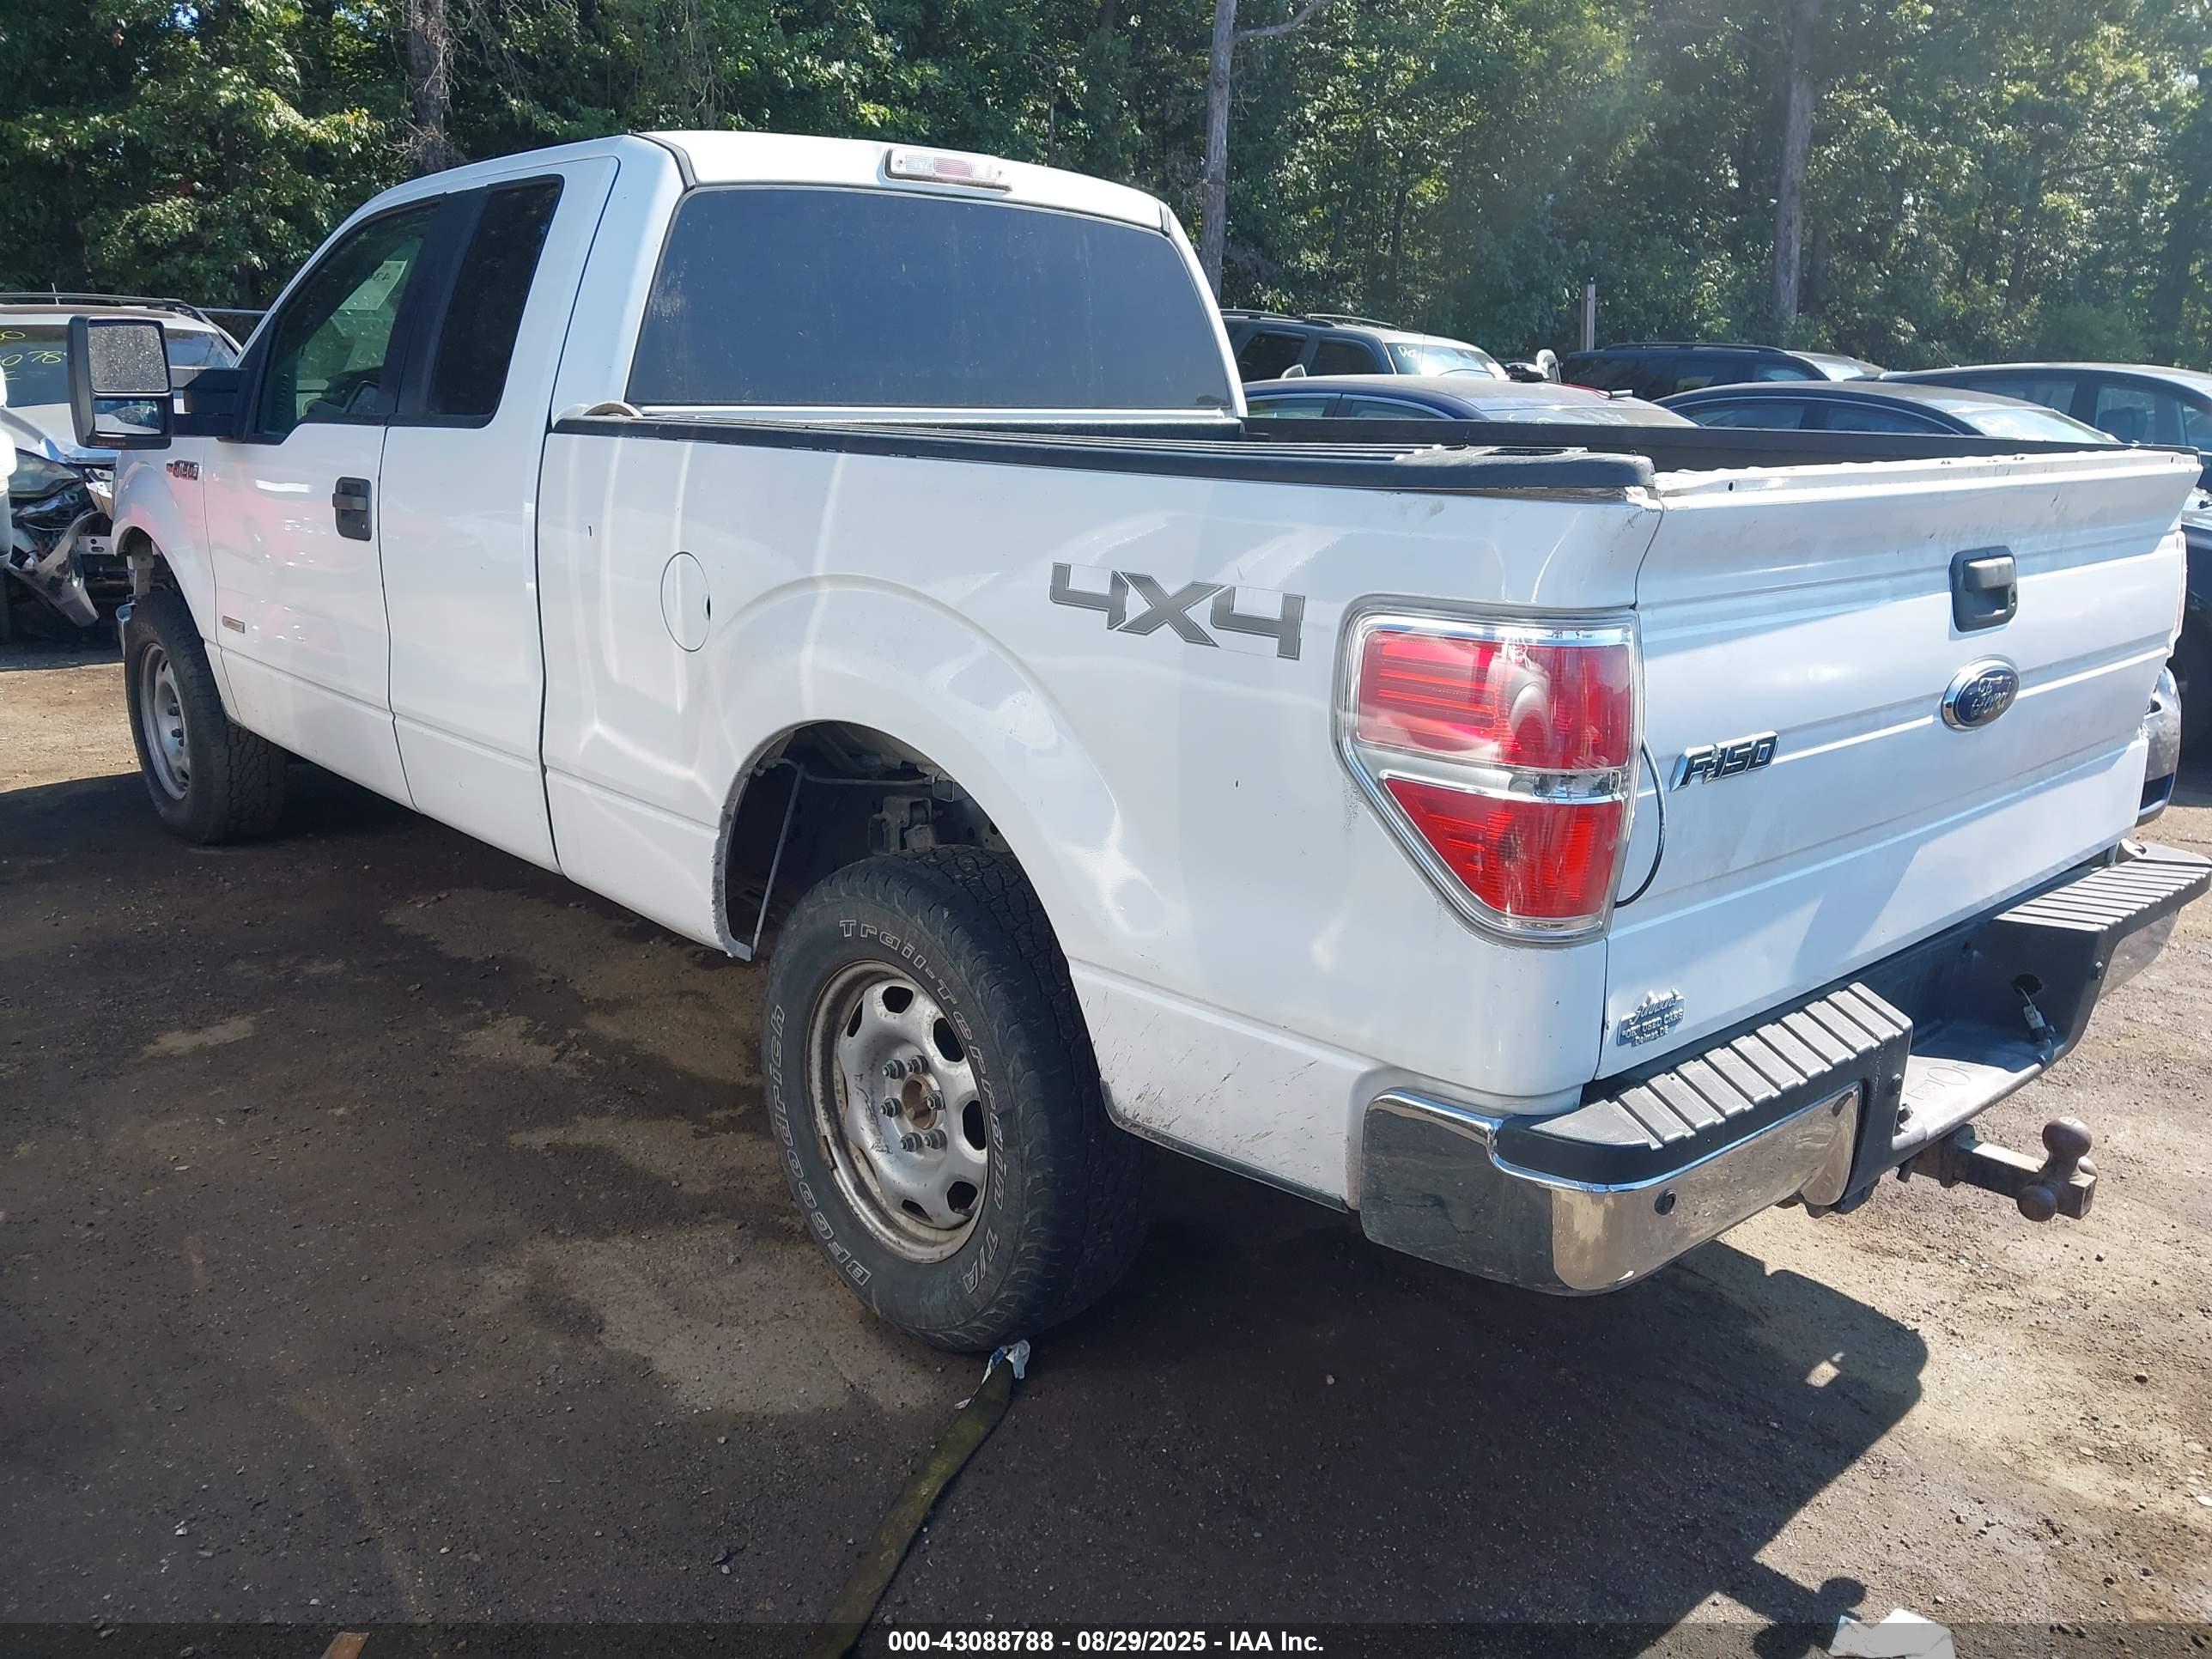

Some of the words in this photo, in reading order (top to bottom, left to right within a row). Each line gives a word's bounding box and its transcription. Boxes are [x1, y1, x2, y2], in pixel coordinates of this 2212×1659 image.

[1049, 562, 1306, 661] 4X4
[1641, 1016, 1662, 1033] USED
[1663, 1007, 1684, 1024] CARS
[962, 1226, 999, 1295] T/A
